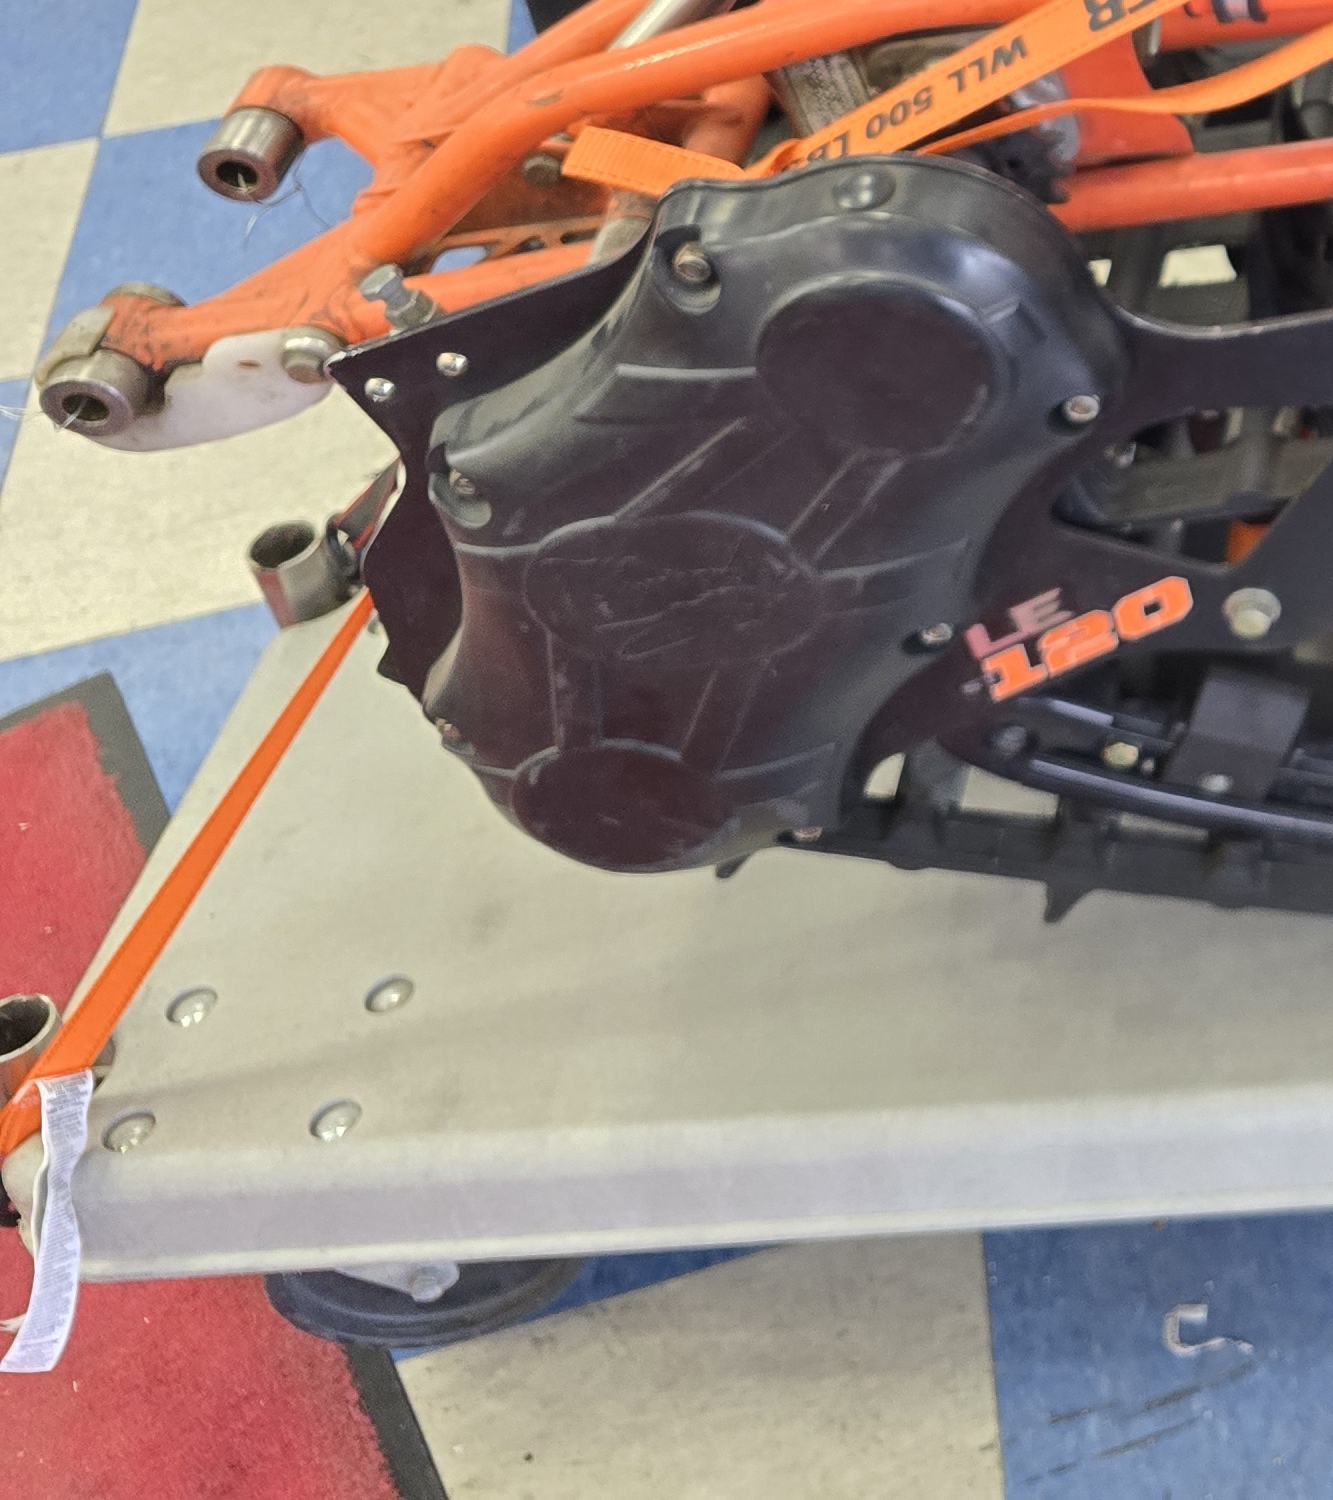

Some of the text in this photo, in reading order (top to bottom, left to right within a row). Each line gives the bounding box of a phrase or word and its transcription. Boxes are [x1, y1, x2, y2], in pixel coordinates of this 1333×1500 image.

[948, 35, 1029, 94] WLL
[864, 87, 934, 141] 500
[781, 129, 851, 173] LB
[963, 587, 1077, 661] LE
[981, 575, 1195, 704] 120
